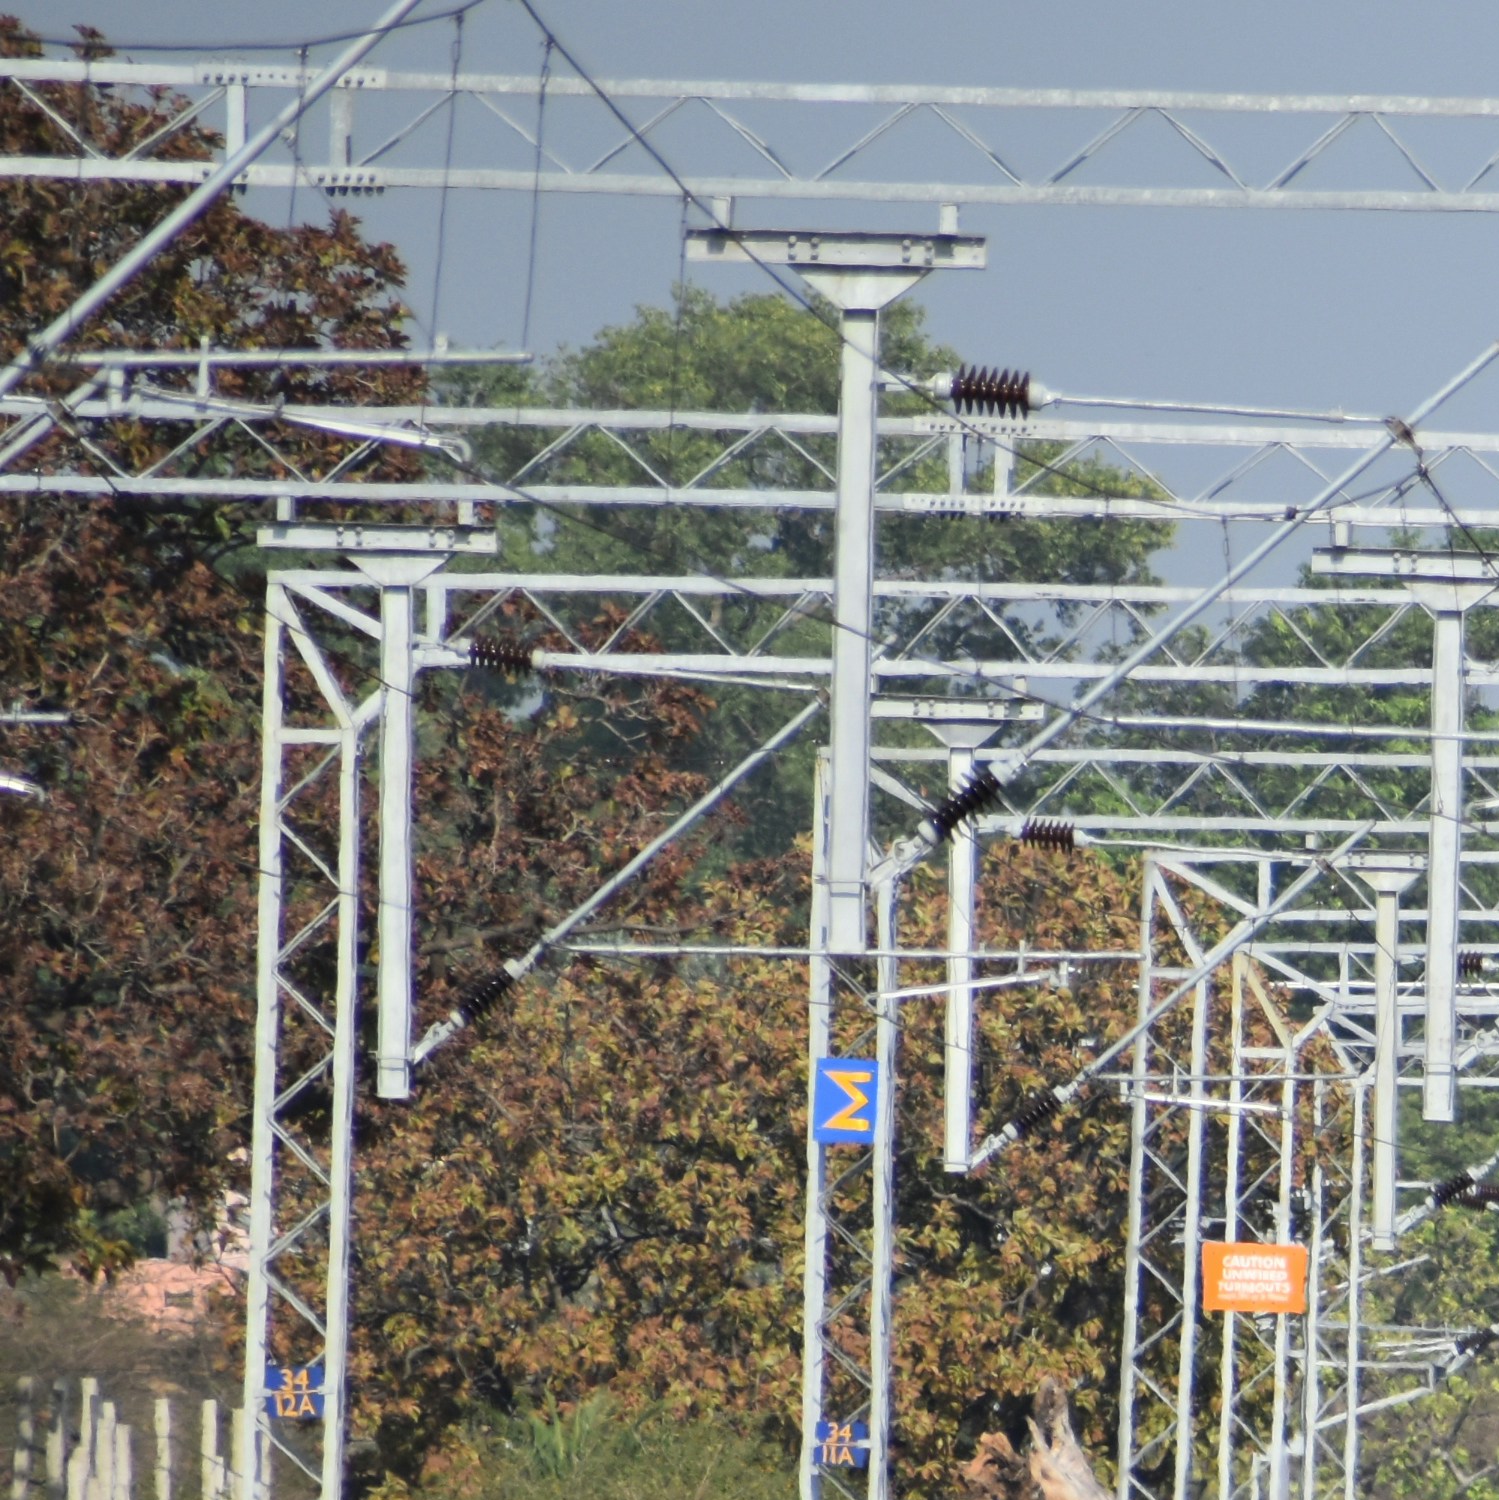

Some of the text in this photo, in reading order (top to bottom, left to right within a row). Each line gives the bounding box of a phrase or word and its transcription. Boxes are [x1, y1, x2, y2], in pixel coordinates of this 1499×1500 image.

[1222, 1255, 1286, 1269] CAUTION
[280, 1368, 308, 1391] 34
[275, 1392, 316, 1417] 12A
[826, 1422, 852, 1443] 34
